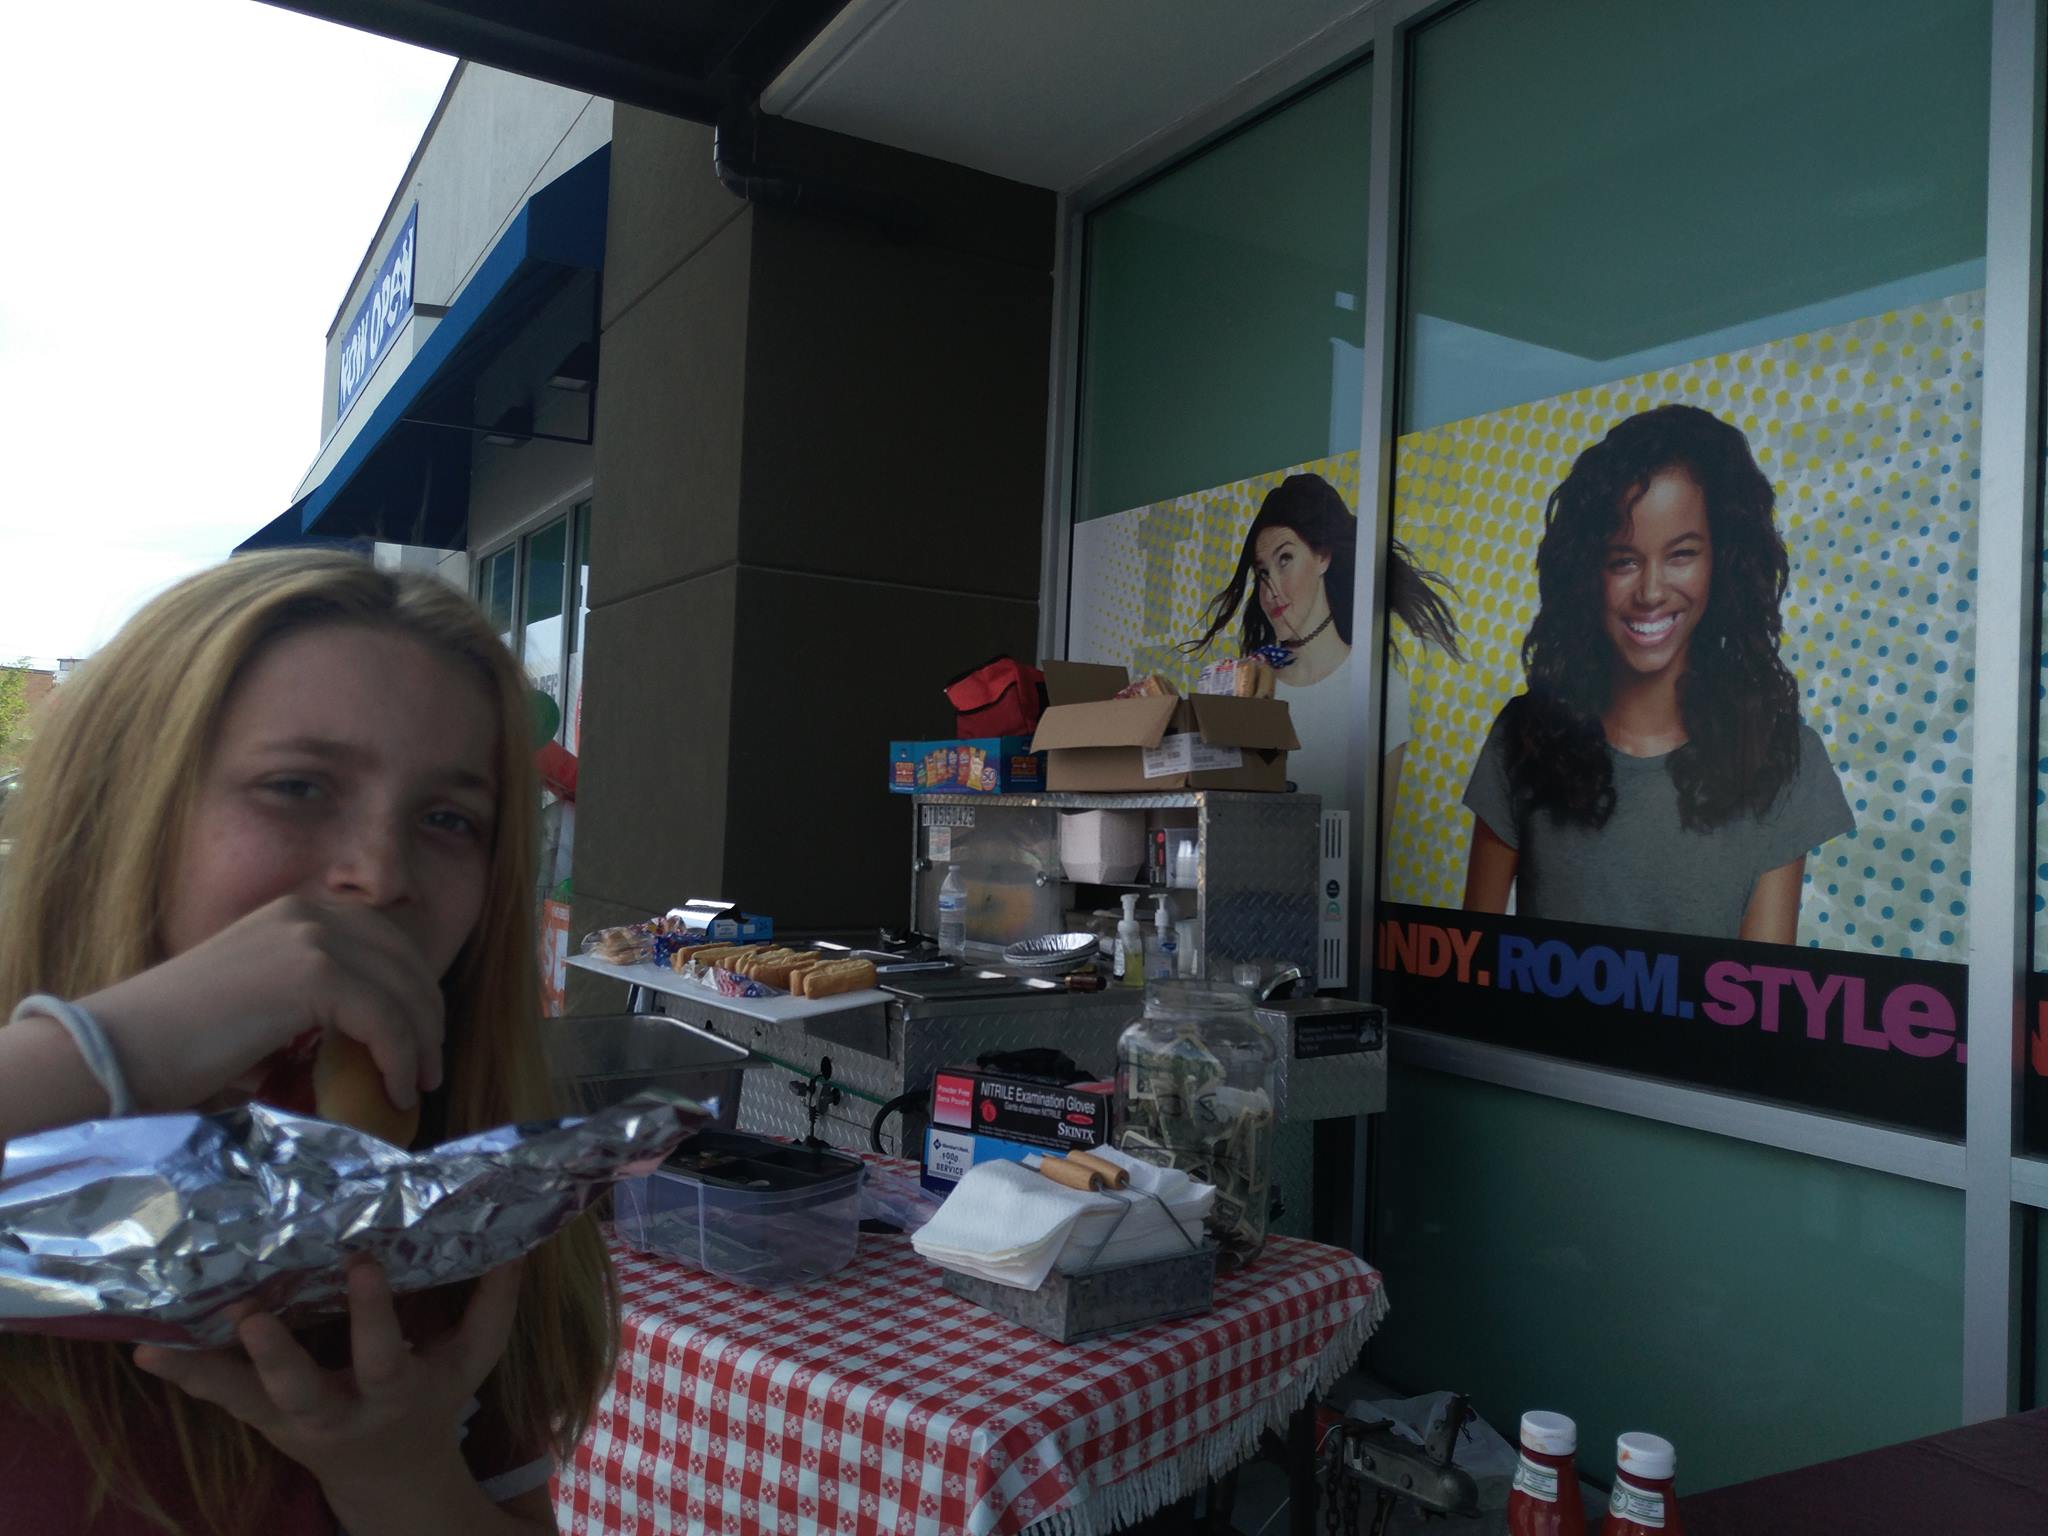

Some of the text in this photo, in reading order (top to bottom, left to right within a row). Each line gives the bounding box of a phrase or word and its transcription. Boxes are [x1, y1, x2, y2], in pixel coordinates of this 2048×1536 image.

[339, 311, 369, 410] NOW
[1498, 933, 1695, 1019] ROOM.
[980, 1081, 1097, 1115] NITRILE Examination Gloves
[1057, 1122, 1095, 1144] SKINTX
[936, 1163, 963, 1176] SERVICE
[942, 1152, 959, 1162] FOOD
